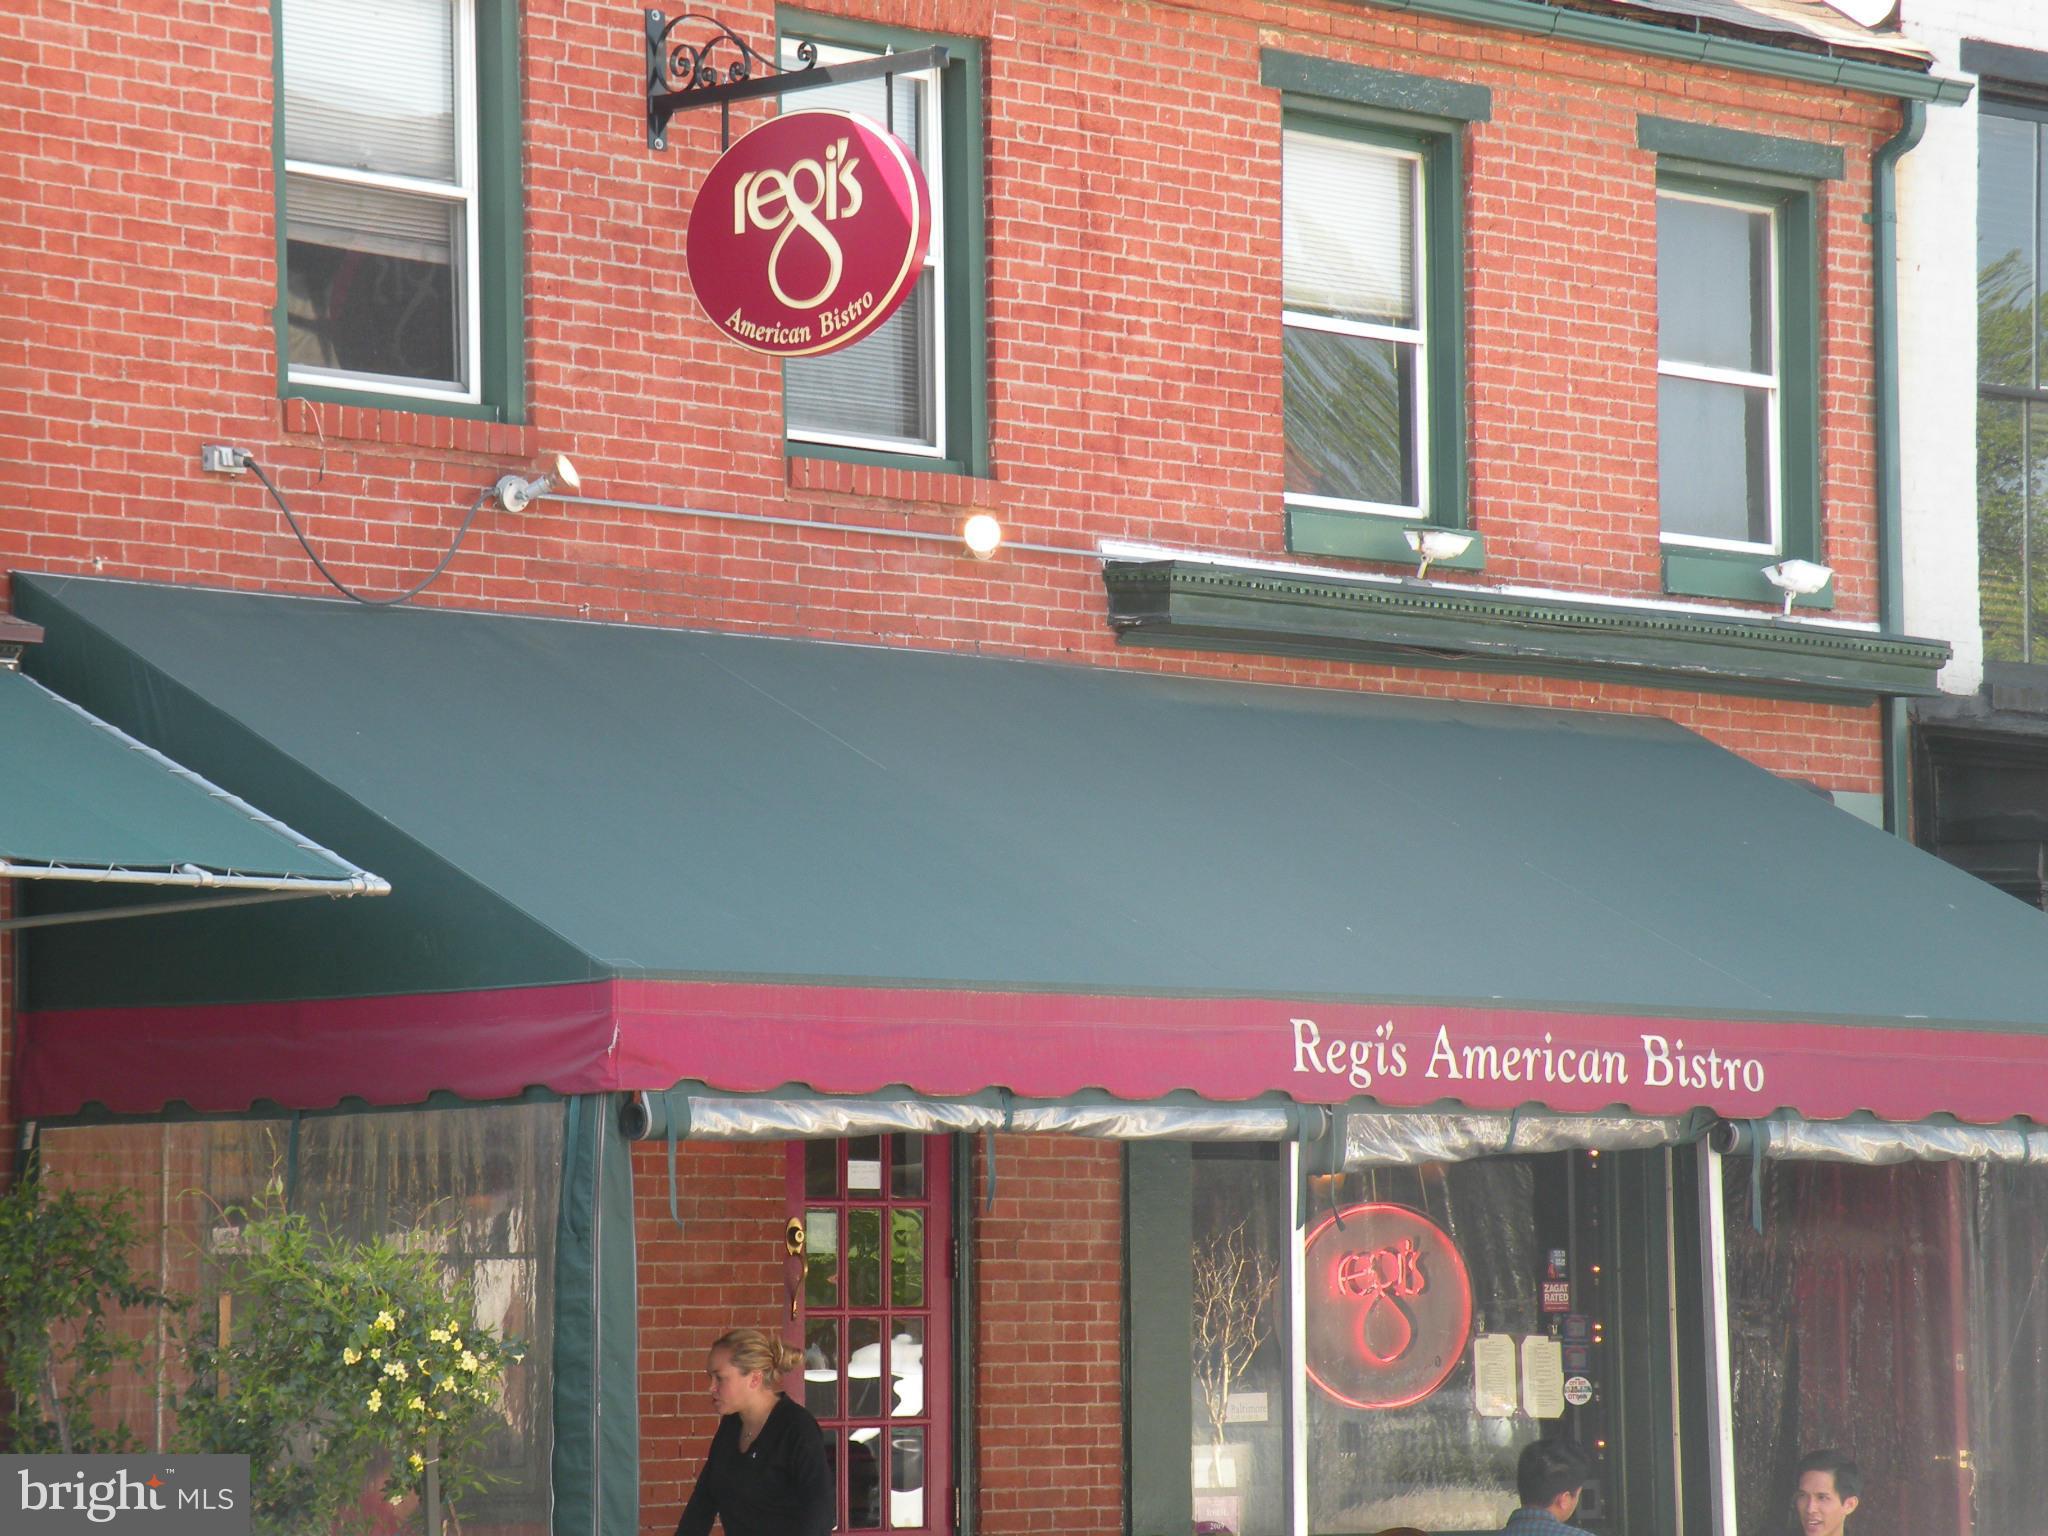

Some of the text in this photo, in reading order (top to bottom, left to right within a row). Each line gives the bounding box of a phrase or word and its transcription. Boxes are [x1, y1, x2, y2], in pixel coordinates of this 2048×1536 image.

[734, 136, 863, 310] regi's
[725, 291, 874, 345] American Bistro
[1289, 1017, 1766, 1093] Regi's American Bistro
[1544, 1284, 1569, 1293] ZAGAT
[1544, 1294, 1569, 1303] RATED
